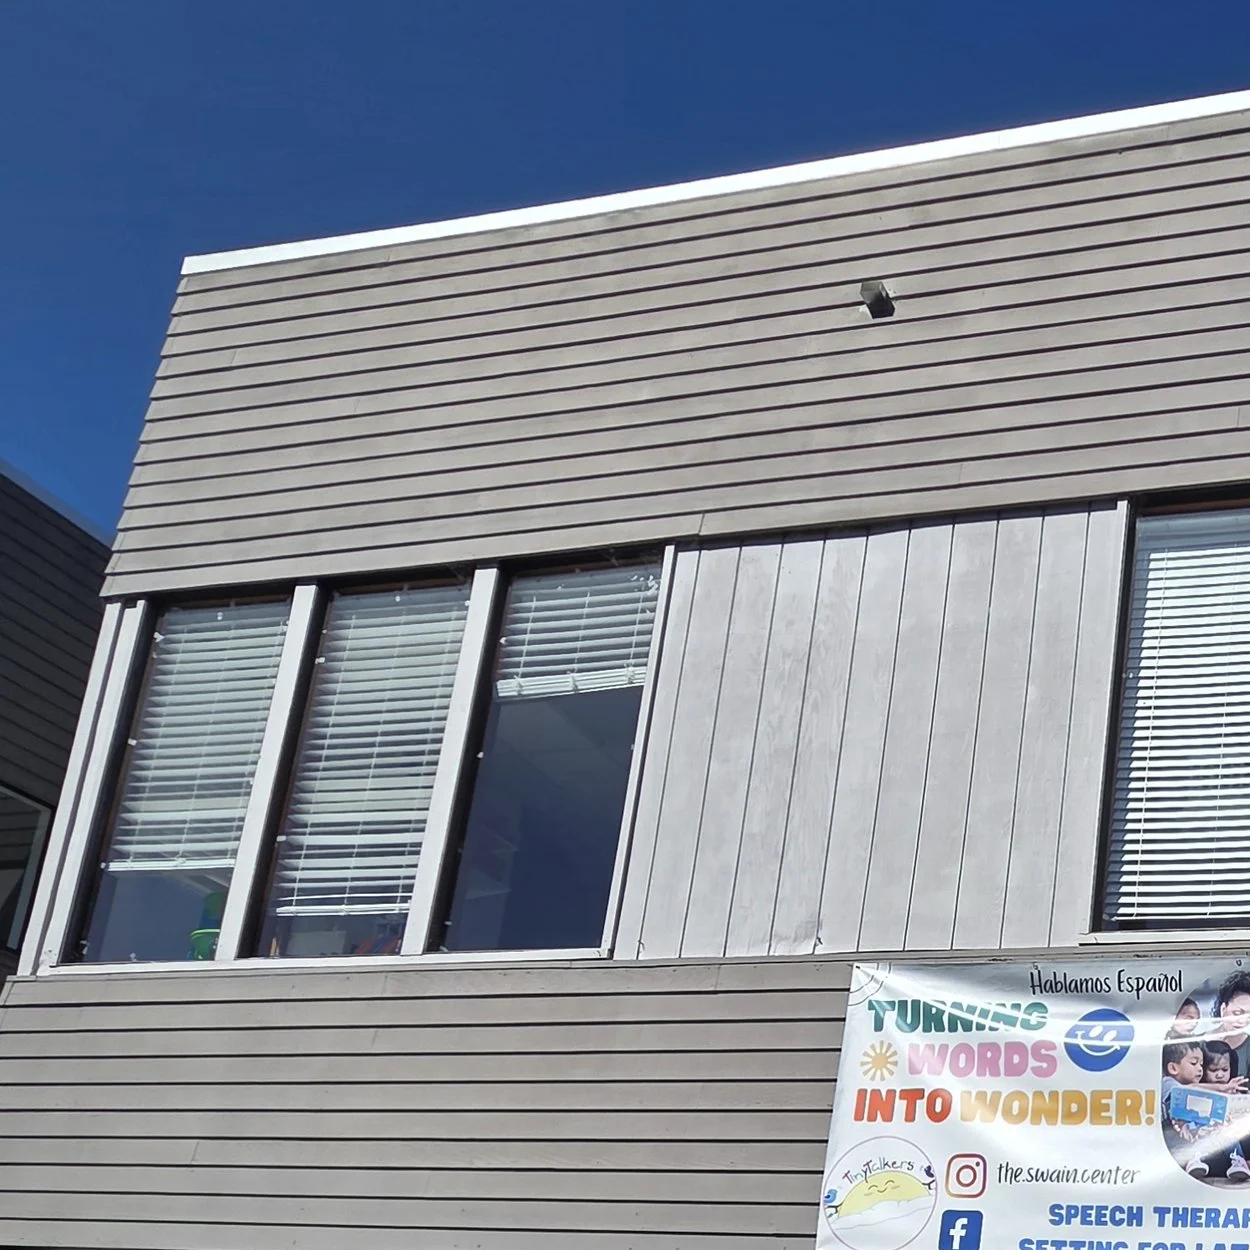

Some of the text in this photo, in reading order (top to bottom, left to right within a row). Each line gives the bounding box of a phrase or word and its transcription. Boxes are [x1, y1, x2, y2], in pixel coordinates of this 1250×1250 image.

[1030, 969, 1183, 1000] Hablamos Español
[868, 999, 1049, 1033] TURNING
[908, 1039, 1058, 1078] WORDS
[853, 1088, 1156, 1126] INTO WONDER!
[1048, 1203, 1143, 1227] SPEECH
